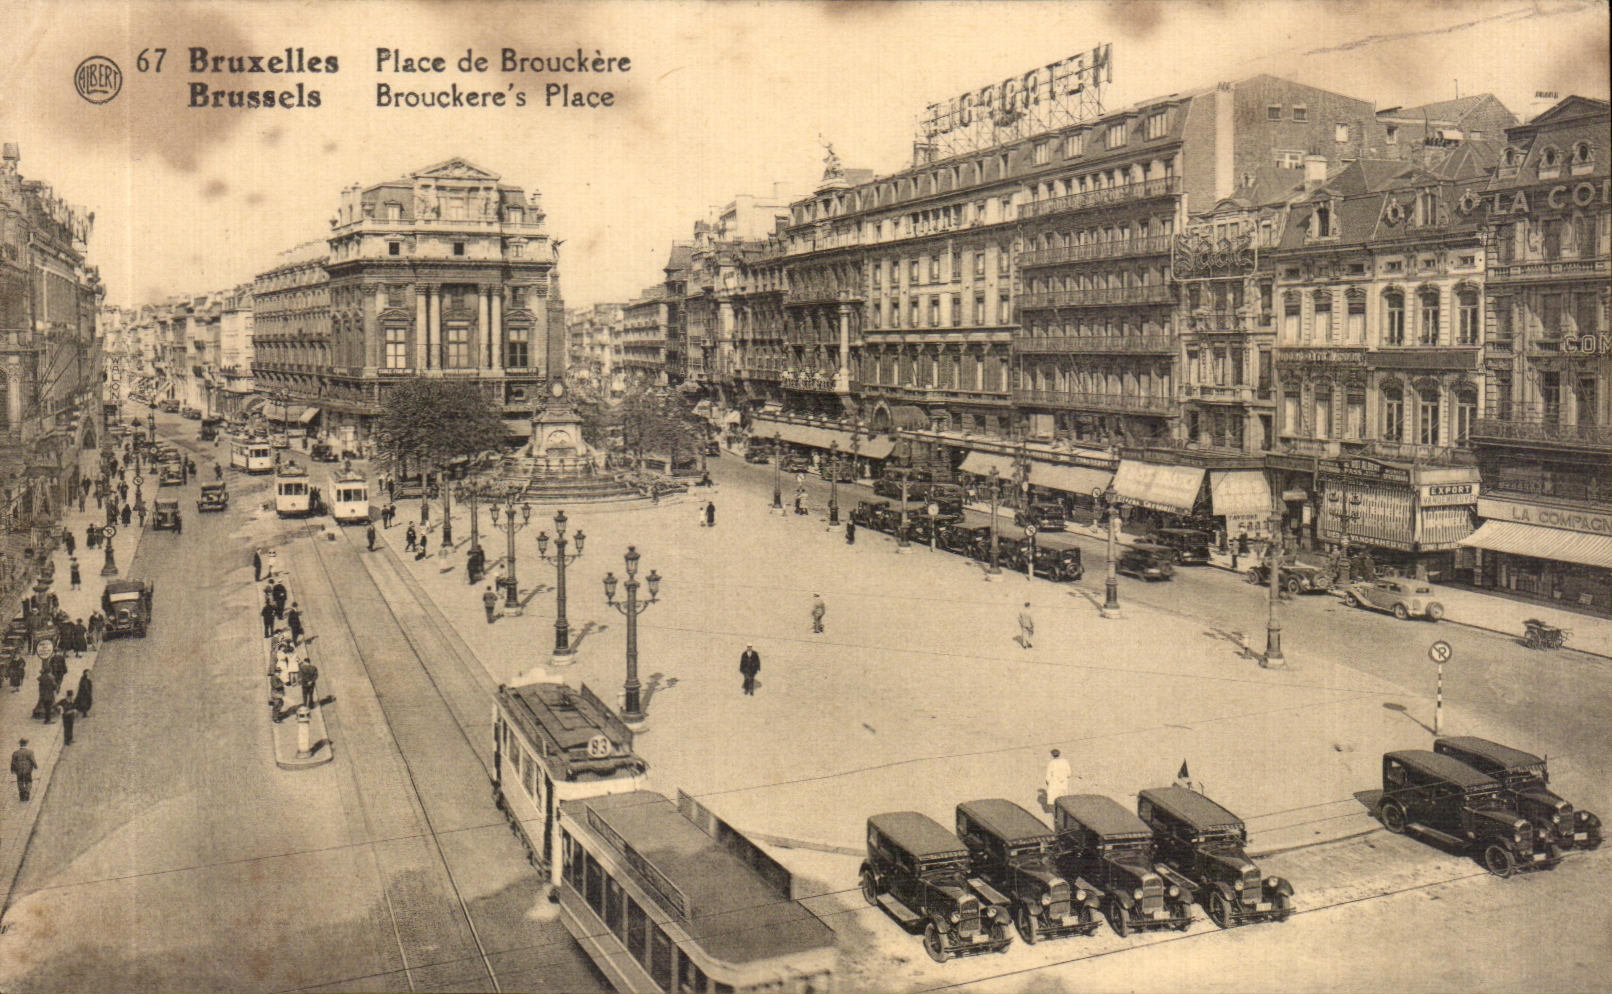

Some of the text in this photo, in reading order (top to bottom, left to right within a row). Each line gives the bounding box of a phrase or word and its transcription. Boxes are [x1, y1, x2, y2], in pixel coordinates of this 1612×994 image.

[1494, 190, 1530, 215] LA
[1430, 485, 1471, 496] EXPORT
[1512, 506, 1530, 521] LA
